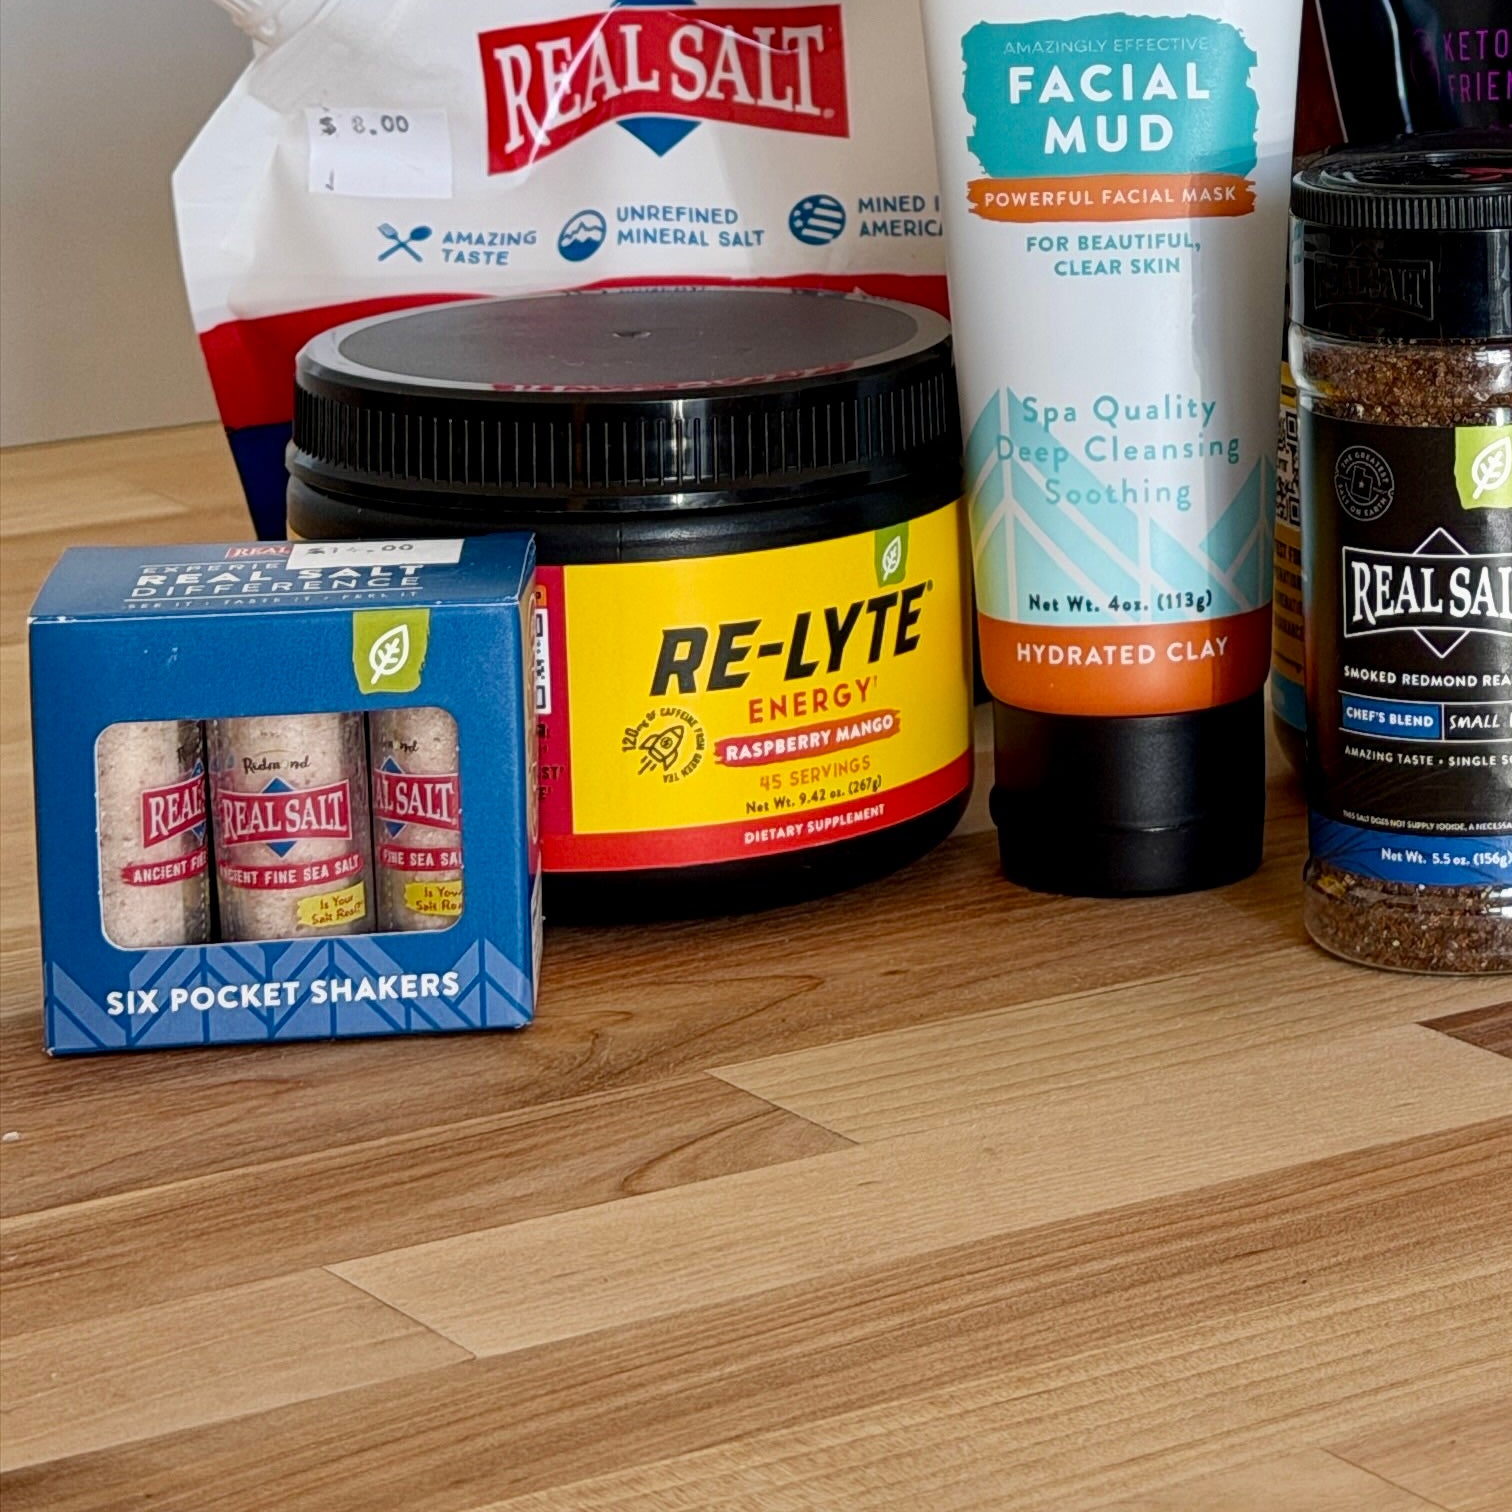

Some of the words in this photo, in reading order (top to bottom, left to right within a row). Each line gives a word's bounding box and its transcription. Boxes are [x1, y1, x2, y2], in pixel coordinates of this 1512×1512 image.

[1002, 39, 1108, 56] AMAZINGLY
[1112, 36, 1210, 54] EFFECTIVE
[1443, 28, 1509, 62] KETO
[493, 24, 660, 155] REAL
[669, 24, 830, 119] SALT
[1009, 62, 1212, 105] FACIAL
[1044, 113, 1175, 155] MUD
[857, 194, 927, 215] MINED
[984, 189, 1095, 208] POWERFUL
[1101, 187, 1175, 205] FACIAL
[1180, 184, 1238, 203] MASK
[616, 205, 739, 225] UNREFINED
[442, 230, 538, 248] AMAZING
[616, 226, 710, 248] MINERAL
[718, 228, 765, 249] SALT
[1026, 235, 1069, 253] FOR
[1077, 233, 1202, 253] BEAUTIFUL,
[442, 247, 510, 267] TASTE
[1053, 258, 1123, 277] CLEAR
[1130, 257, 1182, 274] SKIN
[1021, 395, 1077, 430] Spa
[1092, 393, 1217, 428] Quality
[995, 434, 1070, 473] Deep
[1084, 432, 1241, 465] Cleansing
[1044, 478, 1193, 512] Soothing
[130, 575, 421, 599] DIFFERENCE
[135, 570, 273, 587] REAL
[297, 563, 424, 580] SALT
[1028, 593, 1060, 613] Net
[1066, 594, 1101, 613] Wt.
[1156, 589, 1213, 613] (113g)
[1351, 560, 1446, 626] REAL
[1016, 642, 1156, 666] HYDRATED
[1165, 636, 1229, 663] CLAY
[1343, 664, 1397, 685] SMOKED
[1401, 673, 1478, 688] REDMOND
[1345, 706, 1386, 724] CHEF'S
[1388, 714, 1434, 728] BLEND
[1449, 714, 1501, 731] SMALL
[724, 729, 832, 763] RASPBERRY
[835, 713, 895, 743] MANGO
[1344, 744, 1394, 764] AMAZING
[1397, 753, 1434, 767] TASTE
[1448, 755, 1497, 767] SINGLE
[759, 772, 783, 792] 45
[789, 754, 872, 788] SERVINGS
[222, 798, 283, 841] REAL
[285, 790, 348, 833] SALT
[743, 822, 805, 846] DIETARY
[807, 802, 886, 834] SUPPLEMENT
[1380, 847, 1404, 863] Net
[1405, 849, 1428, 865] Wt.
[1431, 852, 1451, 866] 5.5
[1452, 854, 1471, 866] oz.
[105, 988, 160, 1017] SIX
[170, 981, 300, 1011] POCKET
[310, 971, 460, 1008] SHAKERS
